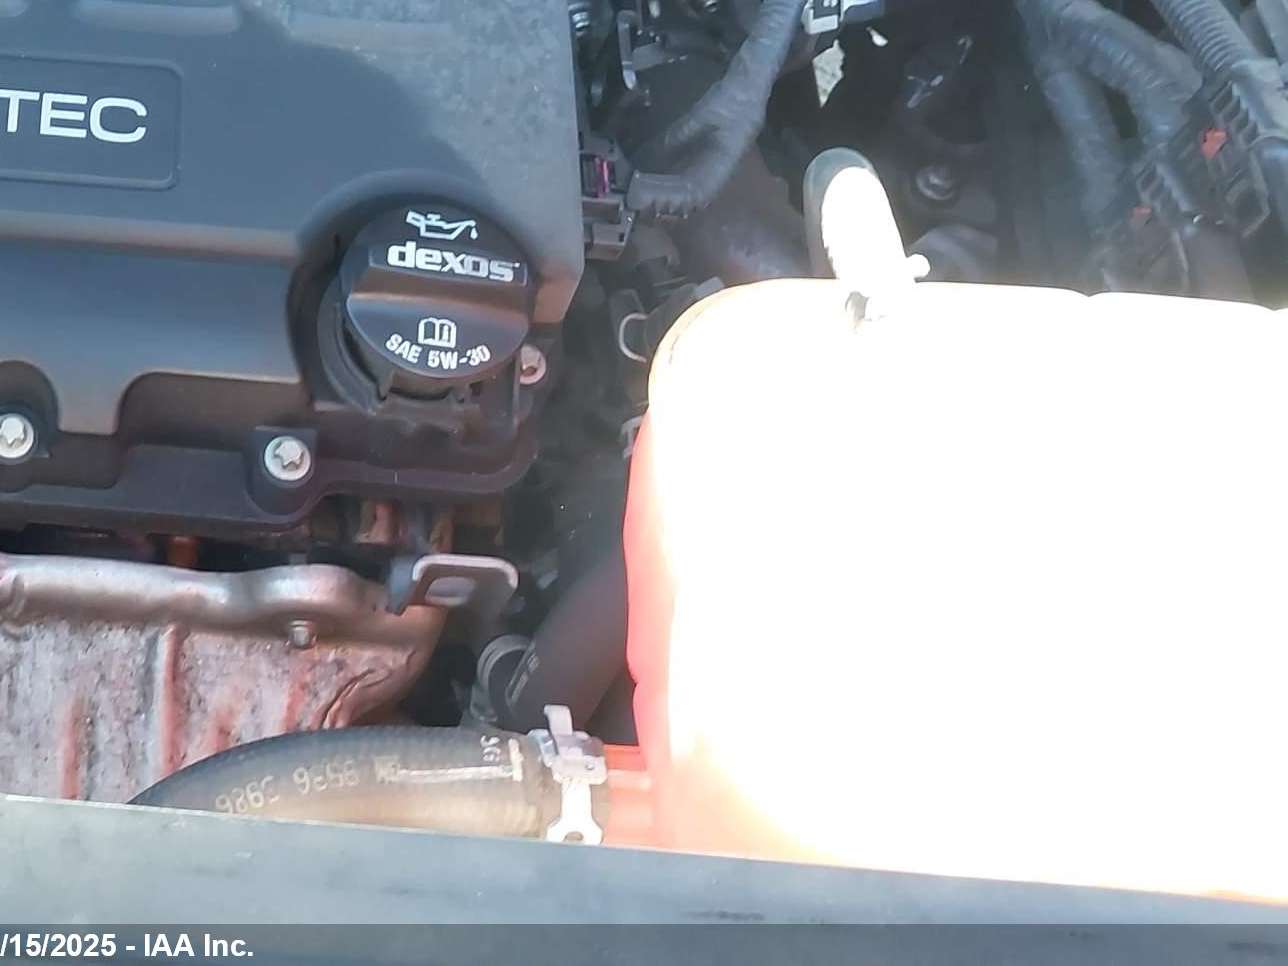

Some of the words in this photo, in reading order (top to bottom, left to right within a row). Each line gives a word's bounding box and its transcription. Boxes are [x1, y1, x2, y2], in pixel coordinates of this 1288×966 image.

[387, 241, 515, 283] dexos
[386, 334, 422, 364] SAE
[427, 345, 491, 370] 5W-30
